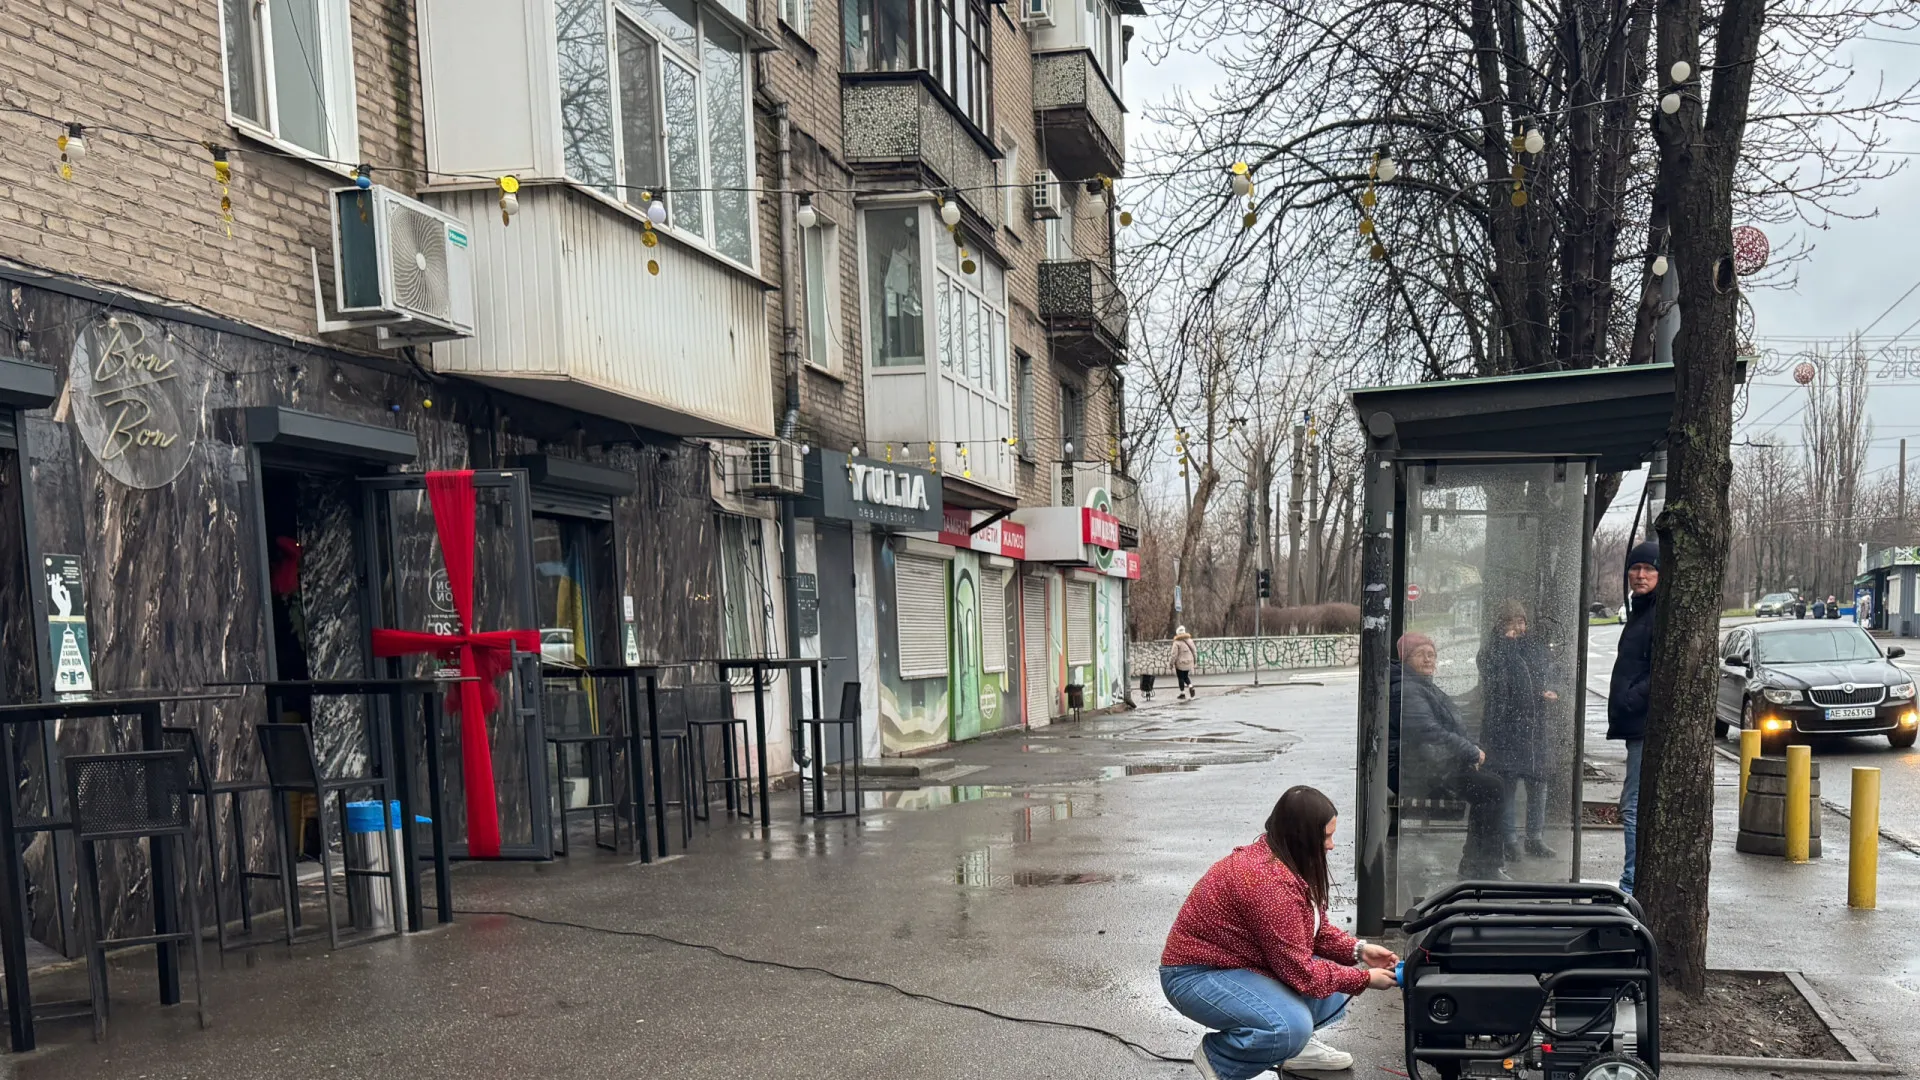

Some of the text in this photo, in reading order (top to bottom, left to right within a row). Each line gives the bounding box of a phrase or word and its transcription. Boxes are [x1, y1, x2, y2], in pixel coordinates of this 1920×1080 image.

[94, 320, 175, 381] Bon
[101, 397, 178, 460] Bon
[846, 463, 930, 511] YULIA
[1830, 708, 1873, 718] AE 3263 KB
